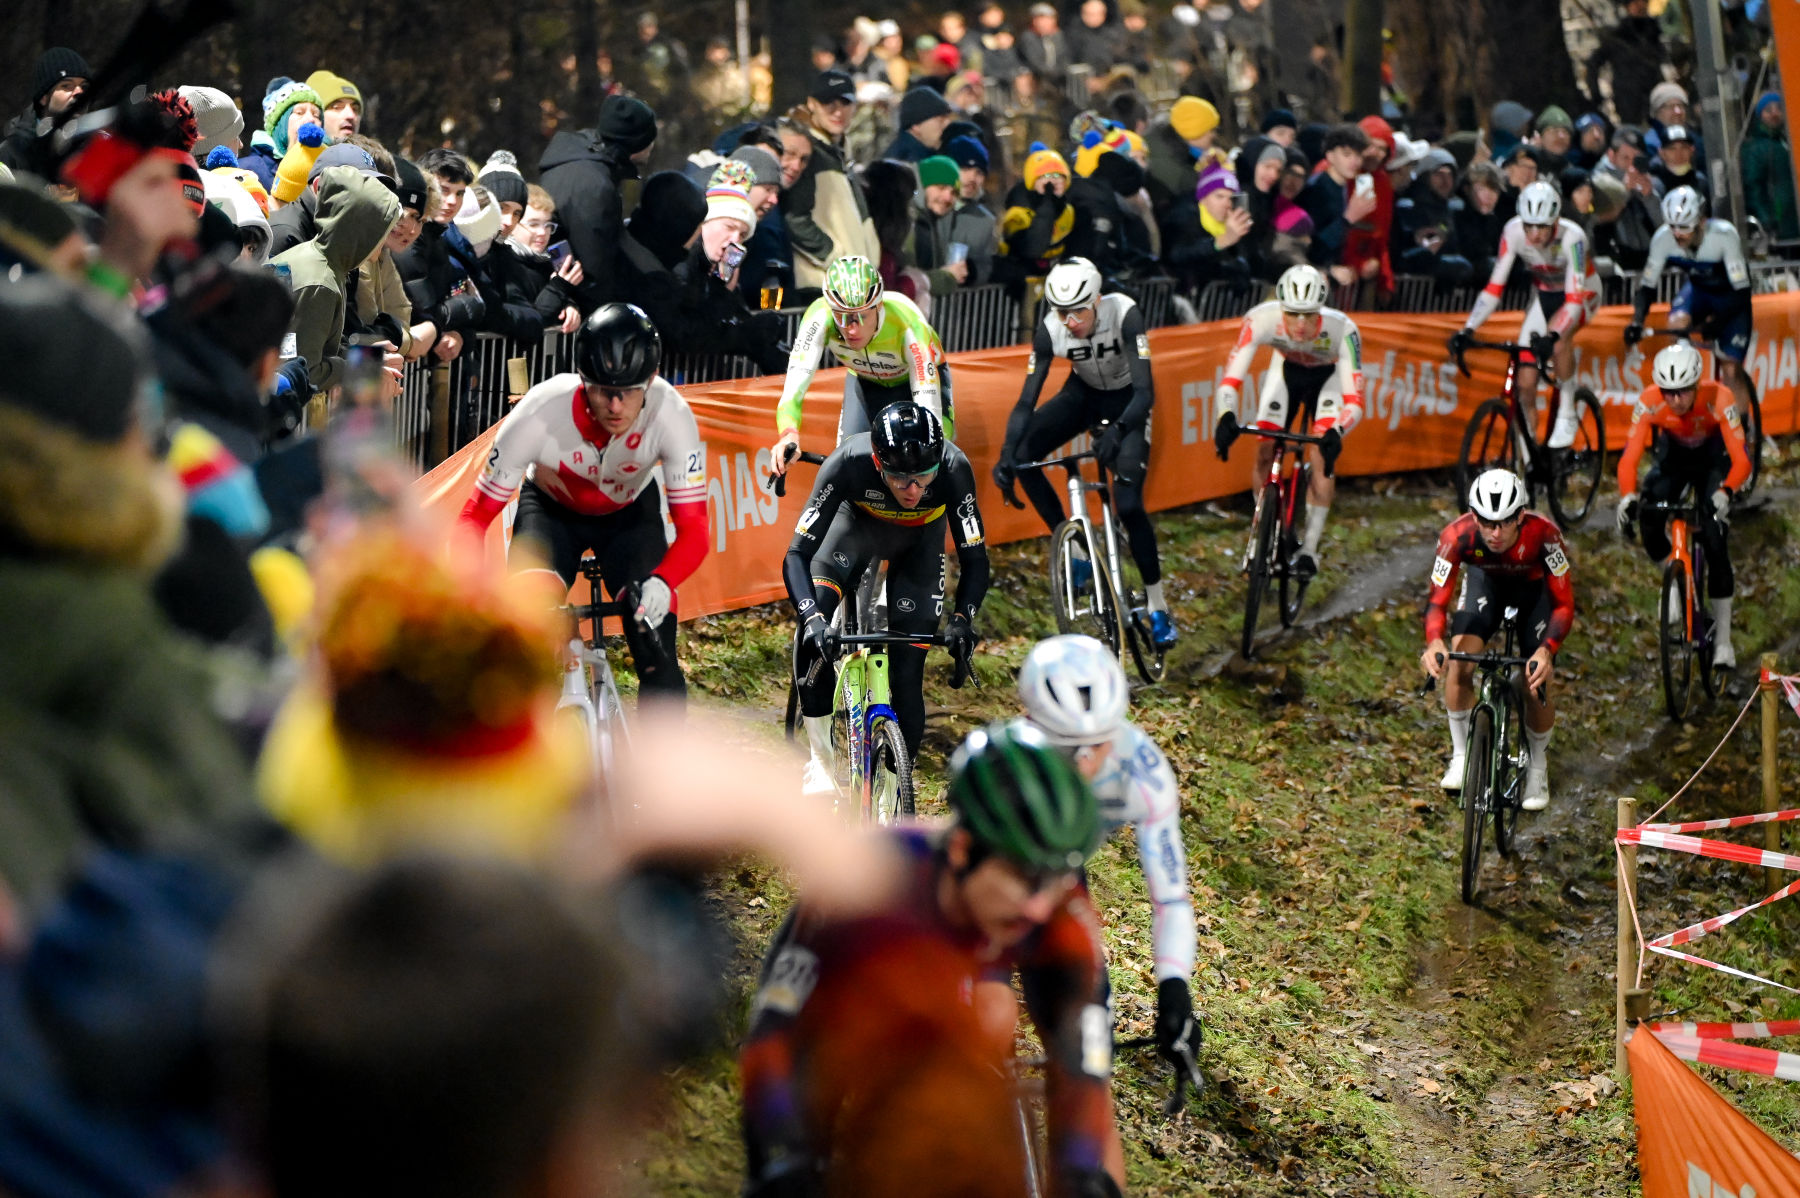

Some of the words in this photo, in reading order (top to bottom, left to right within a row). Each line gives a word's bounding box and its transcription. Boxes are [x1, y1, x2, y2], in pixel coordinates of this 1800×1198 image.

[802, 321, 820, 352] crelan
[1067, 338, 1122, 362] BH
[489, 447, 499, 468] 2
[805, 508, 817, 523] 1
[965, 517, 975, 535] 1
[1433, 560, 1449, 577] 38
[1547, 551, 1564, 570] 38
